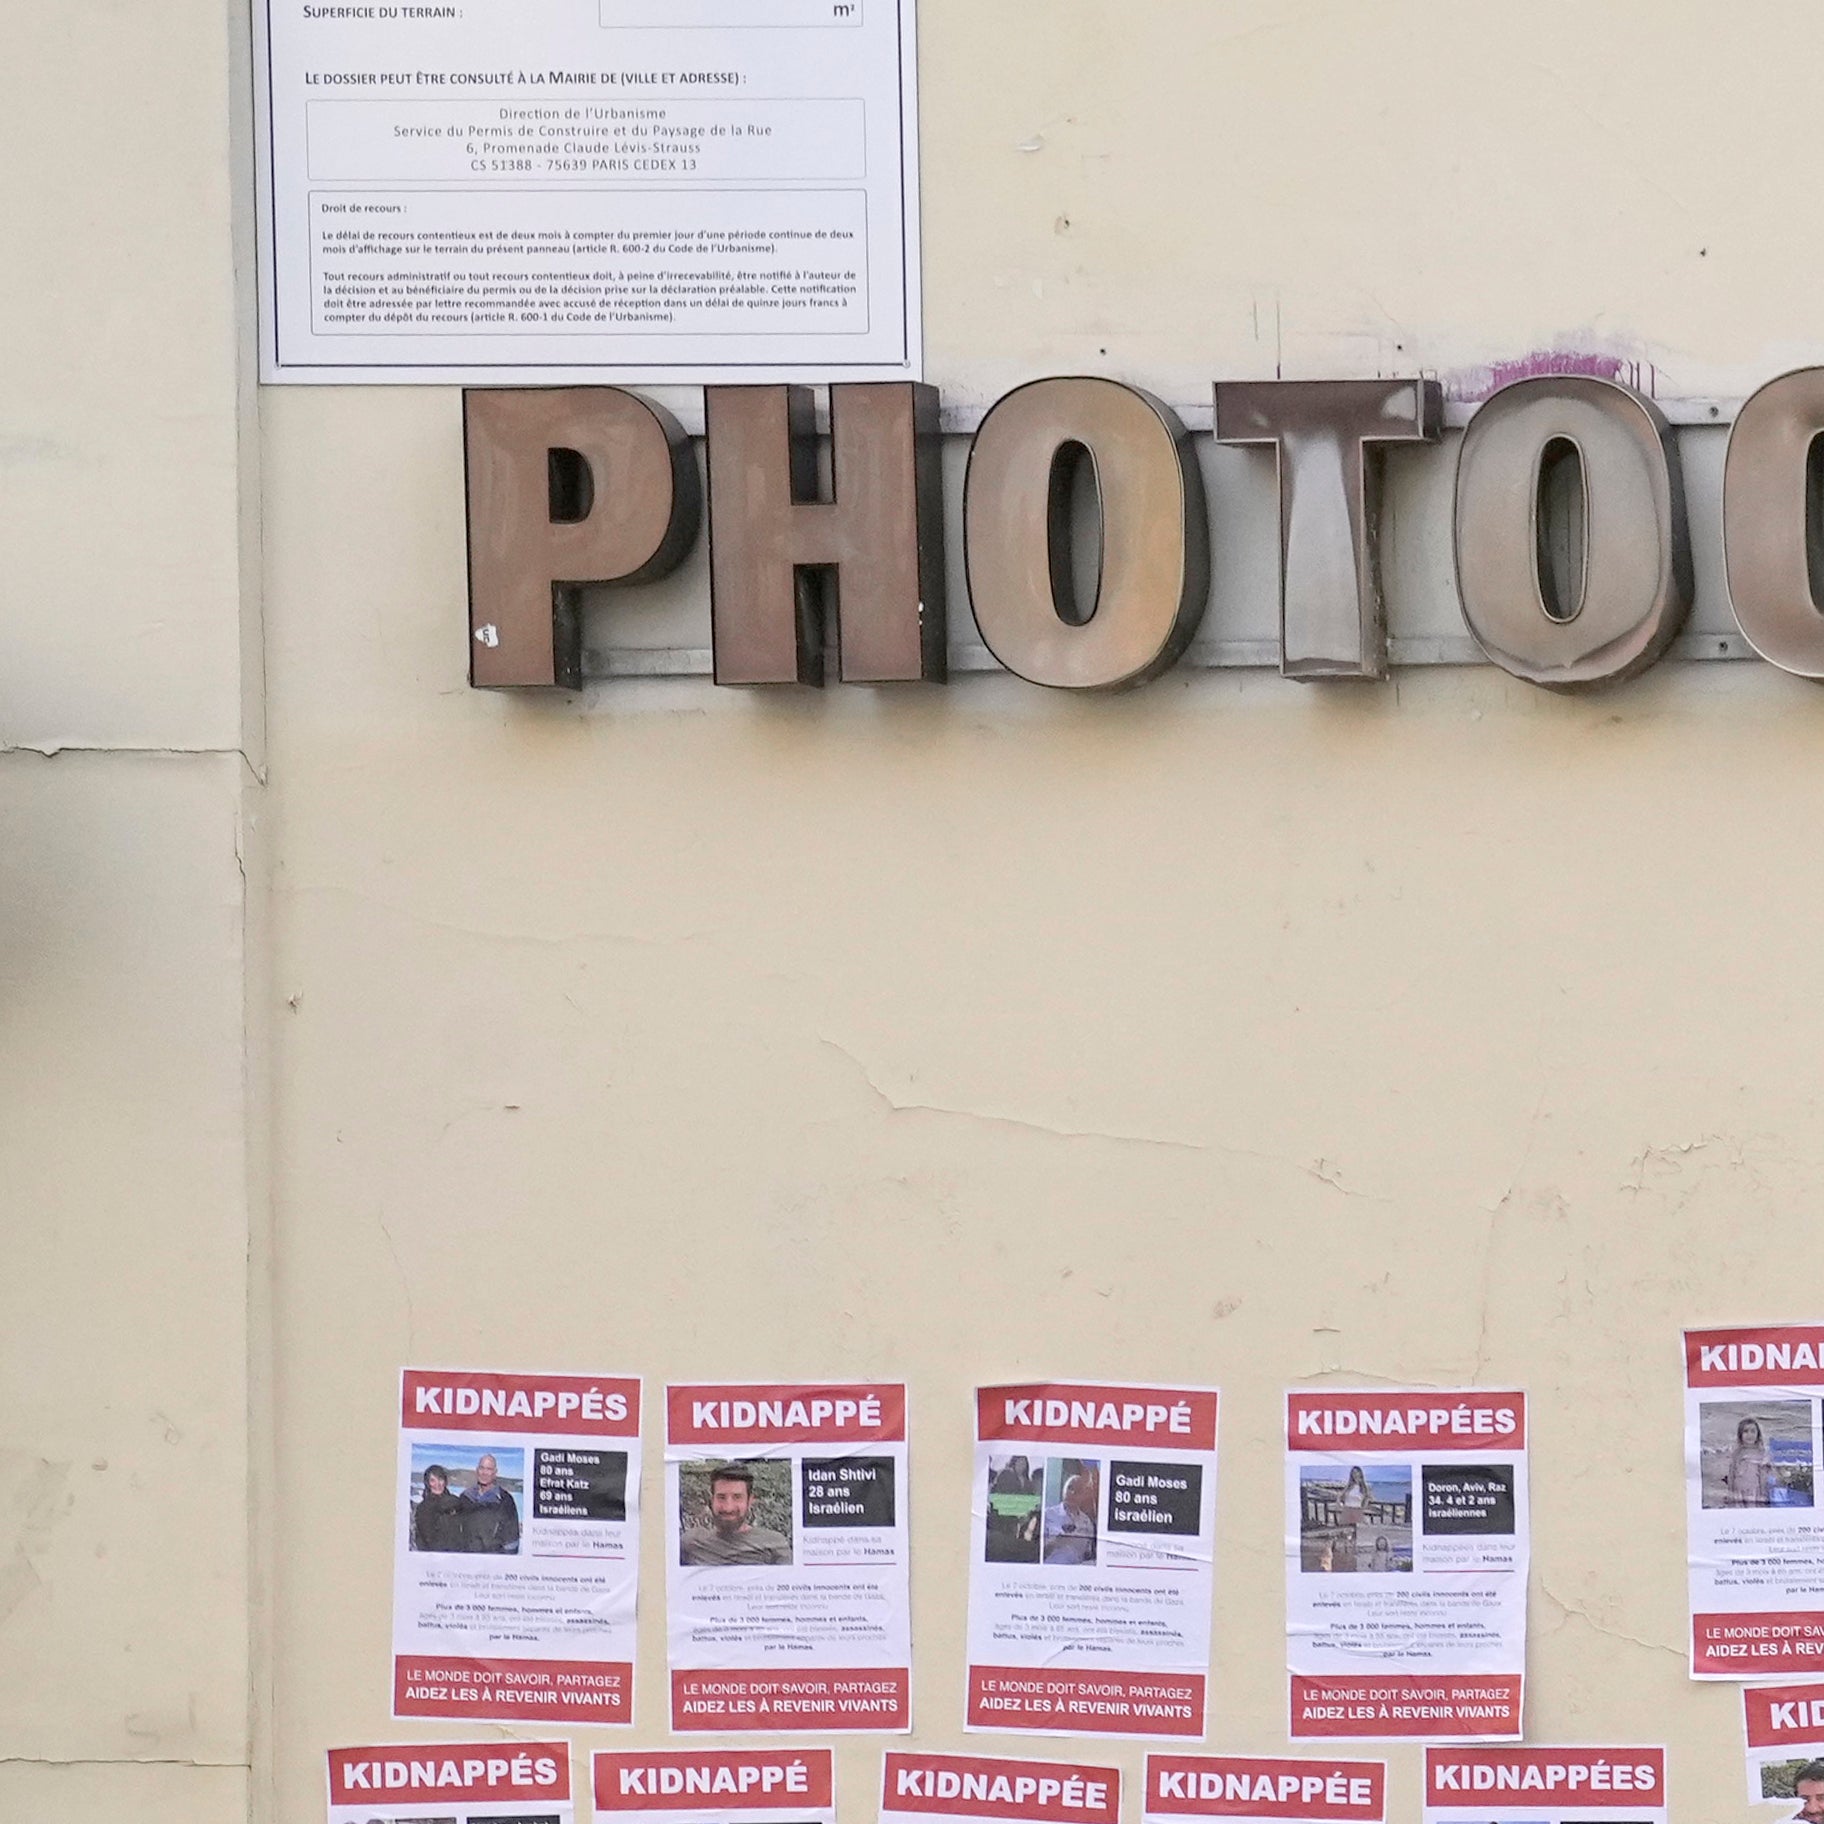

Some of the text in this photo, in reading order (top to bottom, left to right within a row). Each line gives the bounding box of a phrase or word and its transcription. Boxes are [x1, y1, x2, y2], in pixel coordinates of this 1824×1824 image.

[304, 5, 455, 18] SUPERFICIE DU TERRAIN
[306, 72, 318, 84] LE
[324, 74, 376, 84] DOSSIER
[381, 74, 411, 84] PEUT
[416, 72, 445, 84] ÊTRE
[450, 72, 513, 84] CONSULTÉ
[518, 71, 526, 84] À
[530, 74, 545, 84] LA
[550, 72, 596, 84] MAIRIE
[601, 74, 616, 83] DE
[662, 74, 675, 83] ET
[500, 108, 559, 119] Direction
[565, 108, 580, 118] de
[466, 142, 700, 155] 6, Promenade Claude Lévis-Strauss
[471, 160, 696, 170] CS 51388 75639 PARIS CEDEX 13
[322, 204, 346, 212] Droit
[350, 204, 361, 212] de
[416, 1387, 627, 1420] KIDNAPPÉS
[693, 1394, 881, 1428] KIDNAPPÉ
[1006, 1400, 1191, 1433] KIDNAPPÉ
[1298, 1404, 1515, 1434] KIDNAPPÉES
[809, 1469, 876, 1480] Idan Shtivi
[809, 1486, 850, 1497] 28 ans
[1706, 1628, 1720, 1638] LE
[1724, 1627, 1769, 1638] MONDE
[1772, 1626, 1802, 1637] DOIT
[1706, 1644, 1748, 1656] AIDEZ
[1752, 1644, 1778, 1656] LES
[1782, 1640, 1792, 1654] À
[344, 1752, 556, 1788] KIDNAPPÉS
[620, 1760, 807, 1794] KIDNAPPÉ
[1436, 1760, 1655, 1790] KIDNAPPÉES
[898, 1770, 1106, 1809] KIDNAPPÉE
[1160, 1772, 1371, 1804] KIDNAPPÉE
